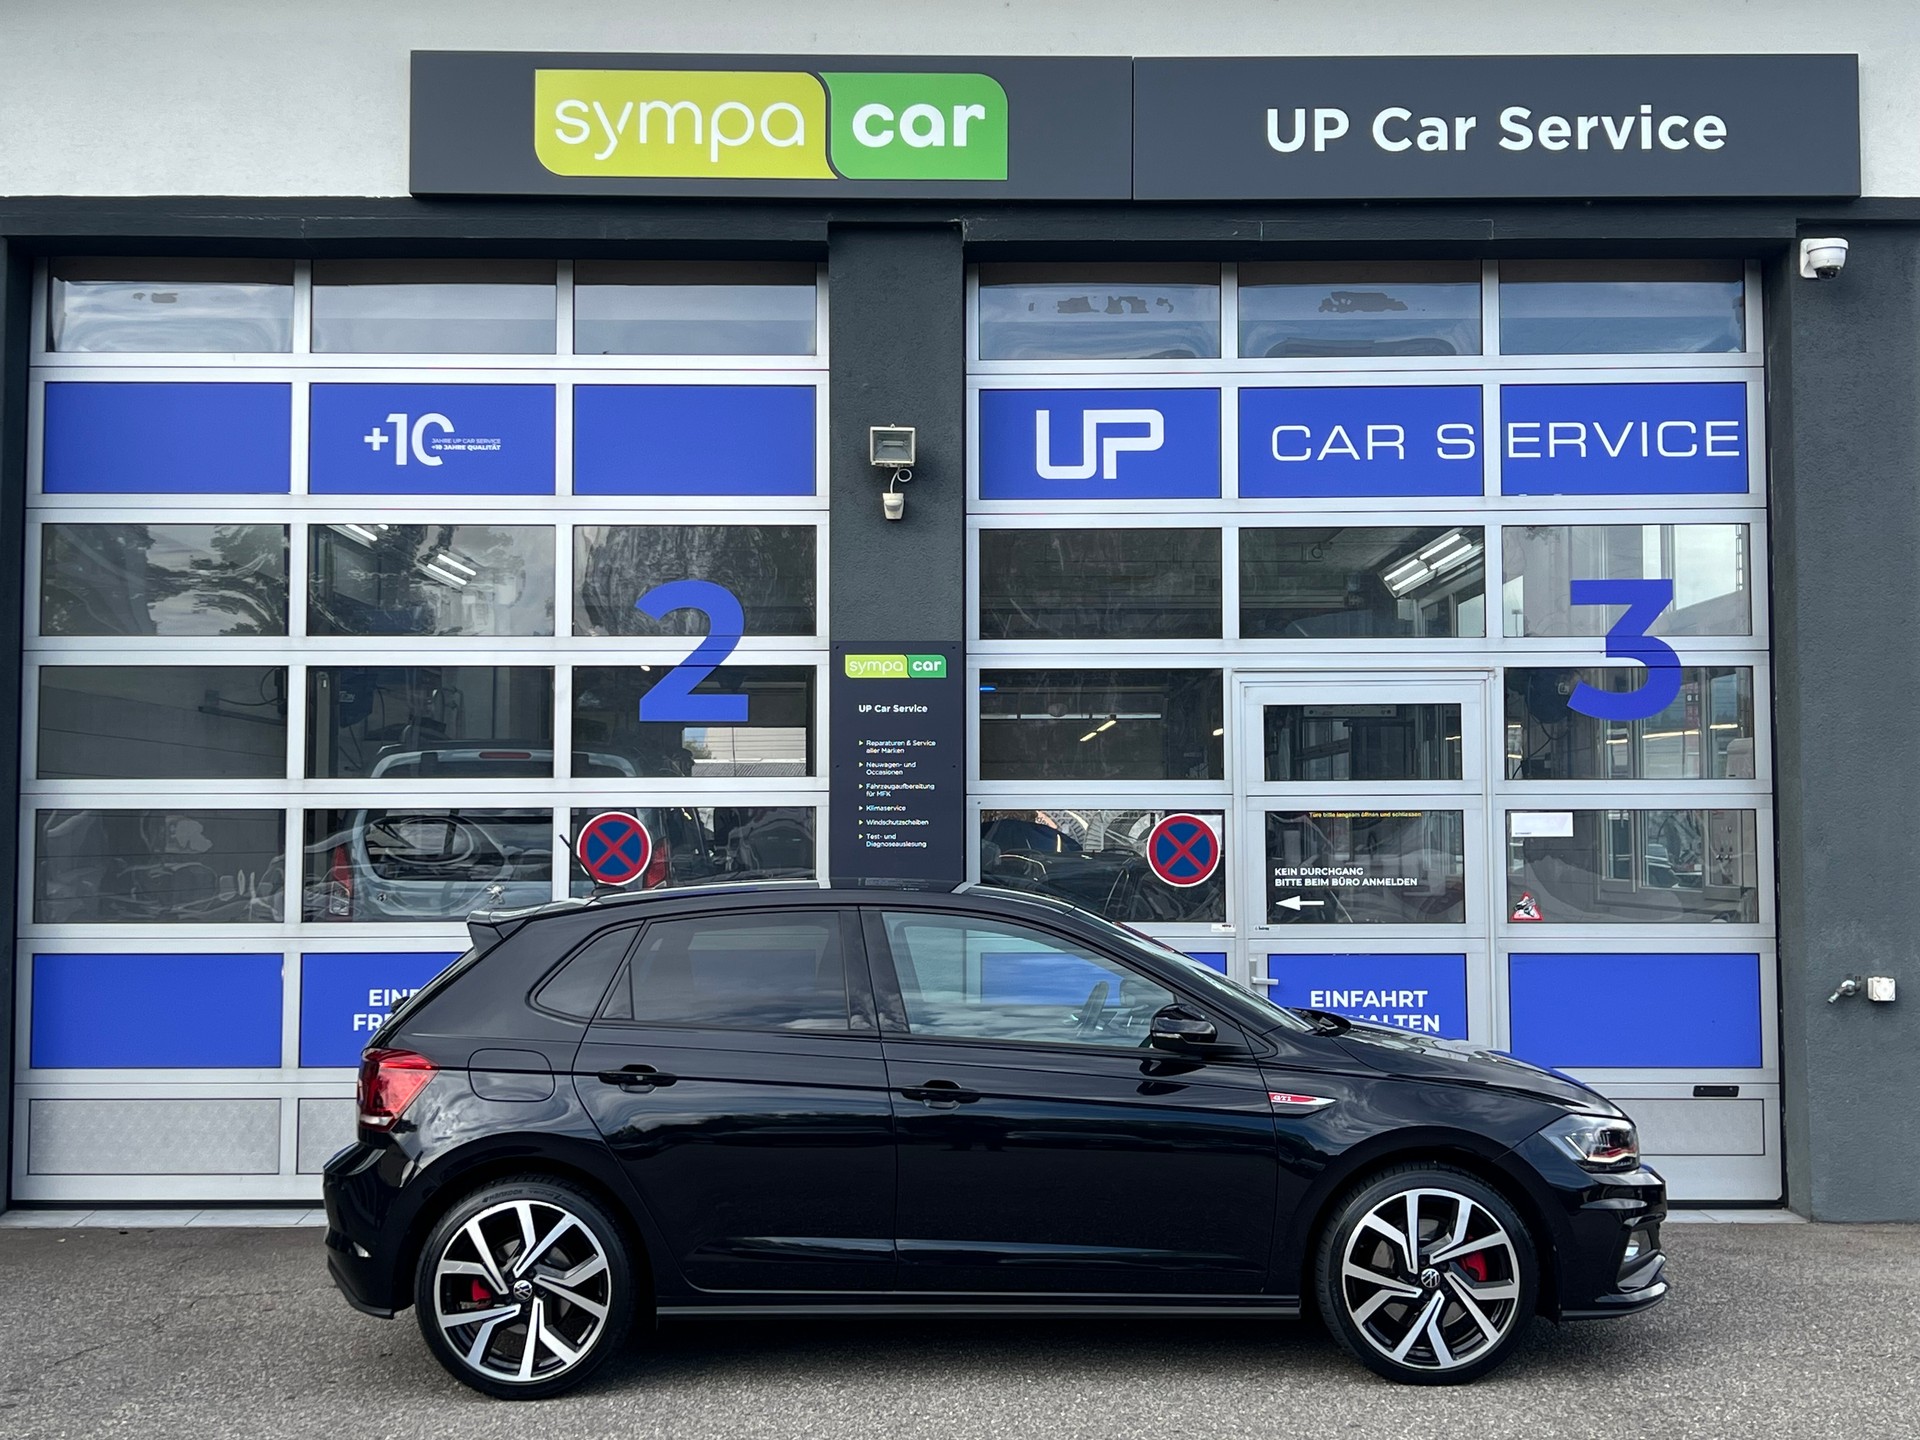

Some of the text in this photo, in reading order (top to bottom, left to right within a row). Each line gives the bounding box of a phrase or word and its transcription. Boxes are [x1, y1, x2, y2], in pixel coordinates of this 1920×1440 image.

[555, 99, 986, 162] sympa car
[1267, 104, 1727, 152] UP Car Service
[1036, 409, 1165, 480] UP
[1271, 424, 1405, 462] CAR
[636, 579, 749, 722] 2
[1567, 578, 1682, 720] 3
[849, 660, 942, 675] sympa car
[858, 704, 928, 713] UP Car Service
[866, 783, 935, 791] Fahrzeugaufbereitung
[1275, 867, 1364, 876] KEIN DURCHGANG
[1275, 876, 1418, 887] BITTE BEIM BÜRO ANMELDEN
[1310, 990, 1429, 1008] EINFAHRT
